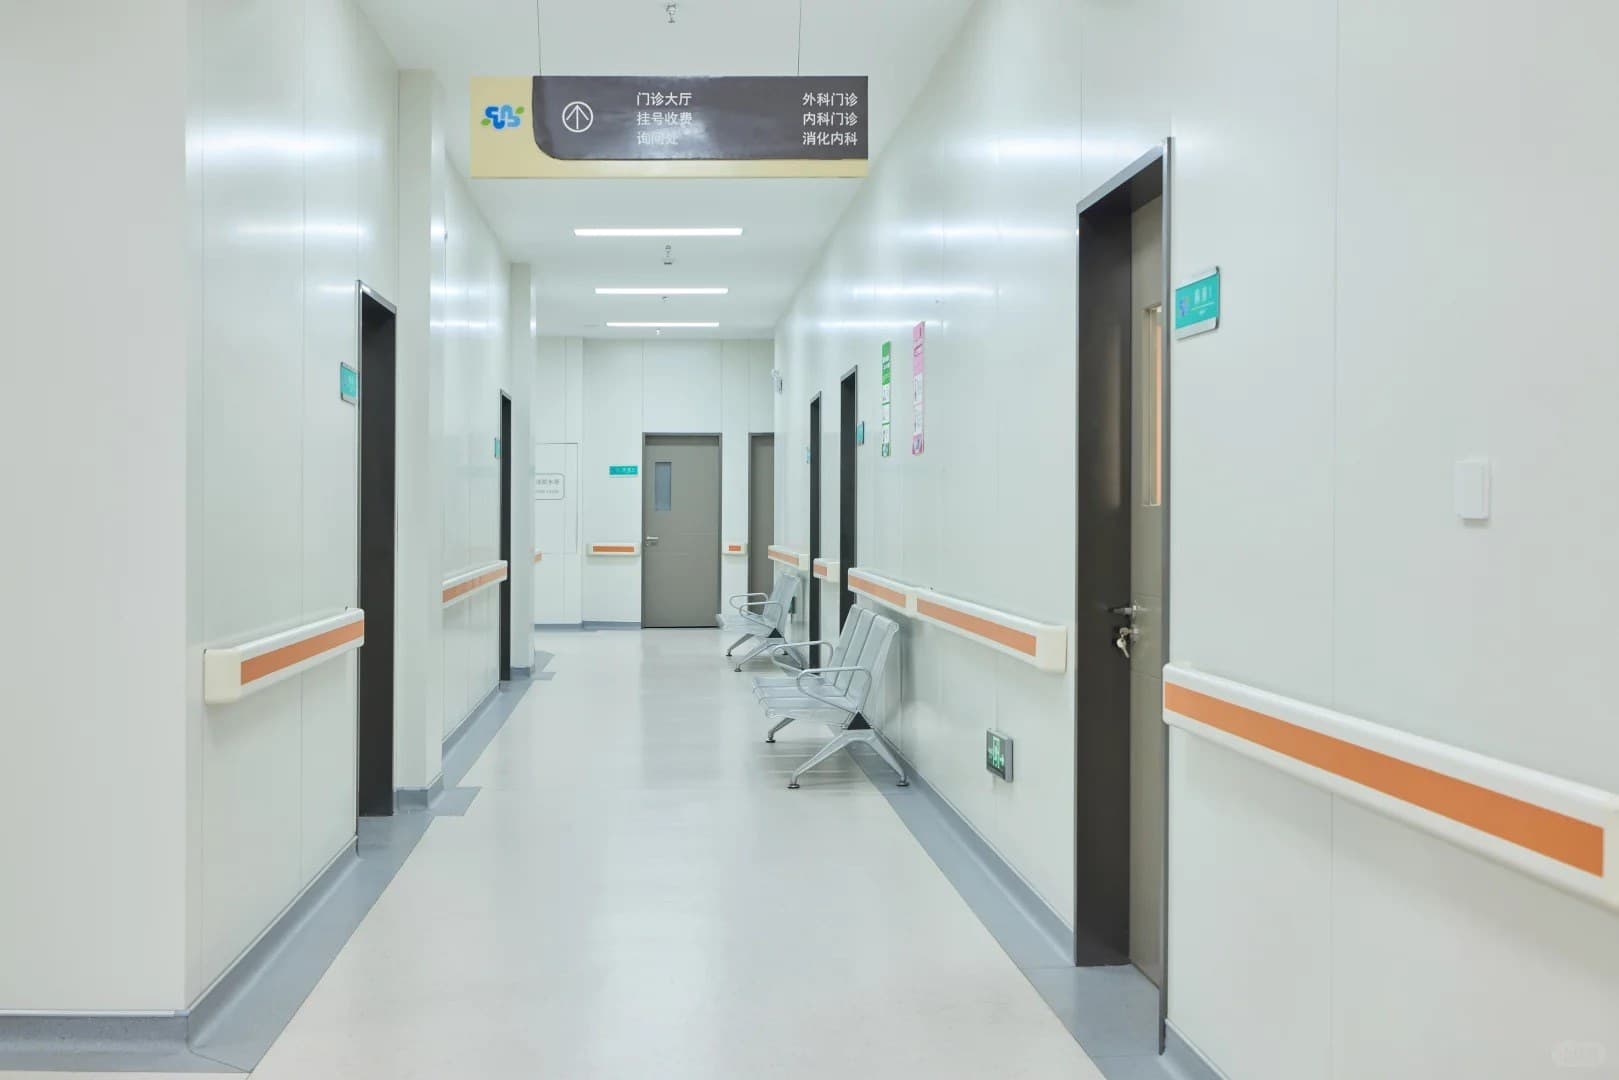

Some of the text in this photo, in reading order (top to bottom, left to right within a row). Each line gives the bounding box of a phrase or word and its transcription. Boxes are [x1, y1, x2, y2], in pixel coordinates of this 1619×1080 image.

[636, 91, 692, 106] 门诊大厅
[802, 92, 858, 107] 外科门诊
[636, 111, 692, 127] 挂号收费
[802, 111, 858, 127] 内科门诊
[802, 131, 858, 146] 消化内科
